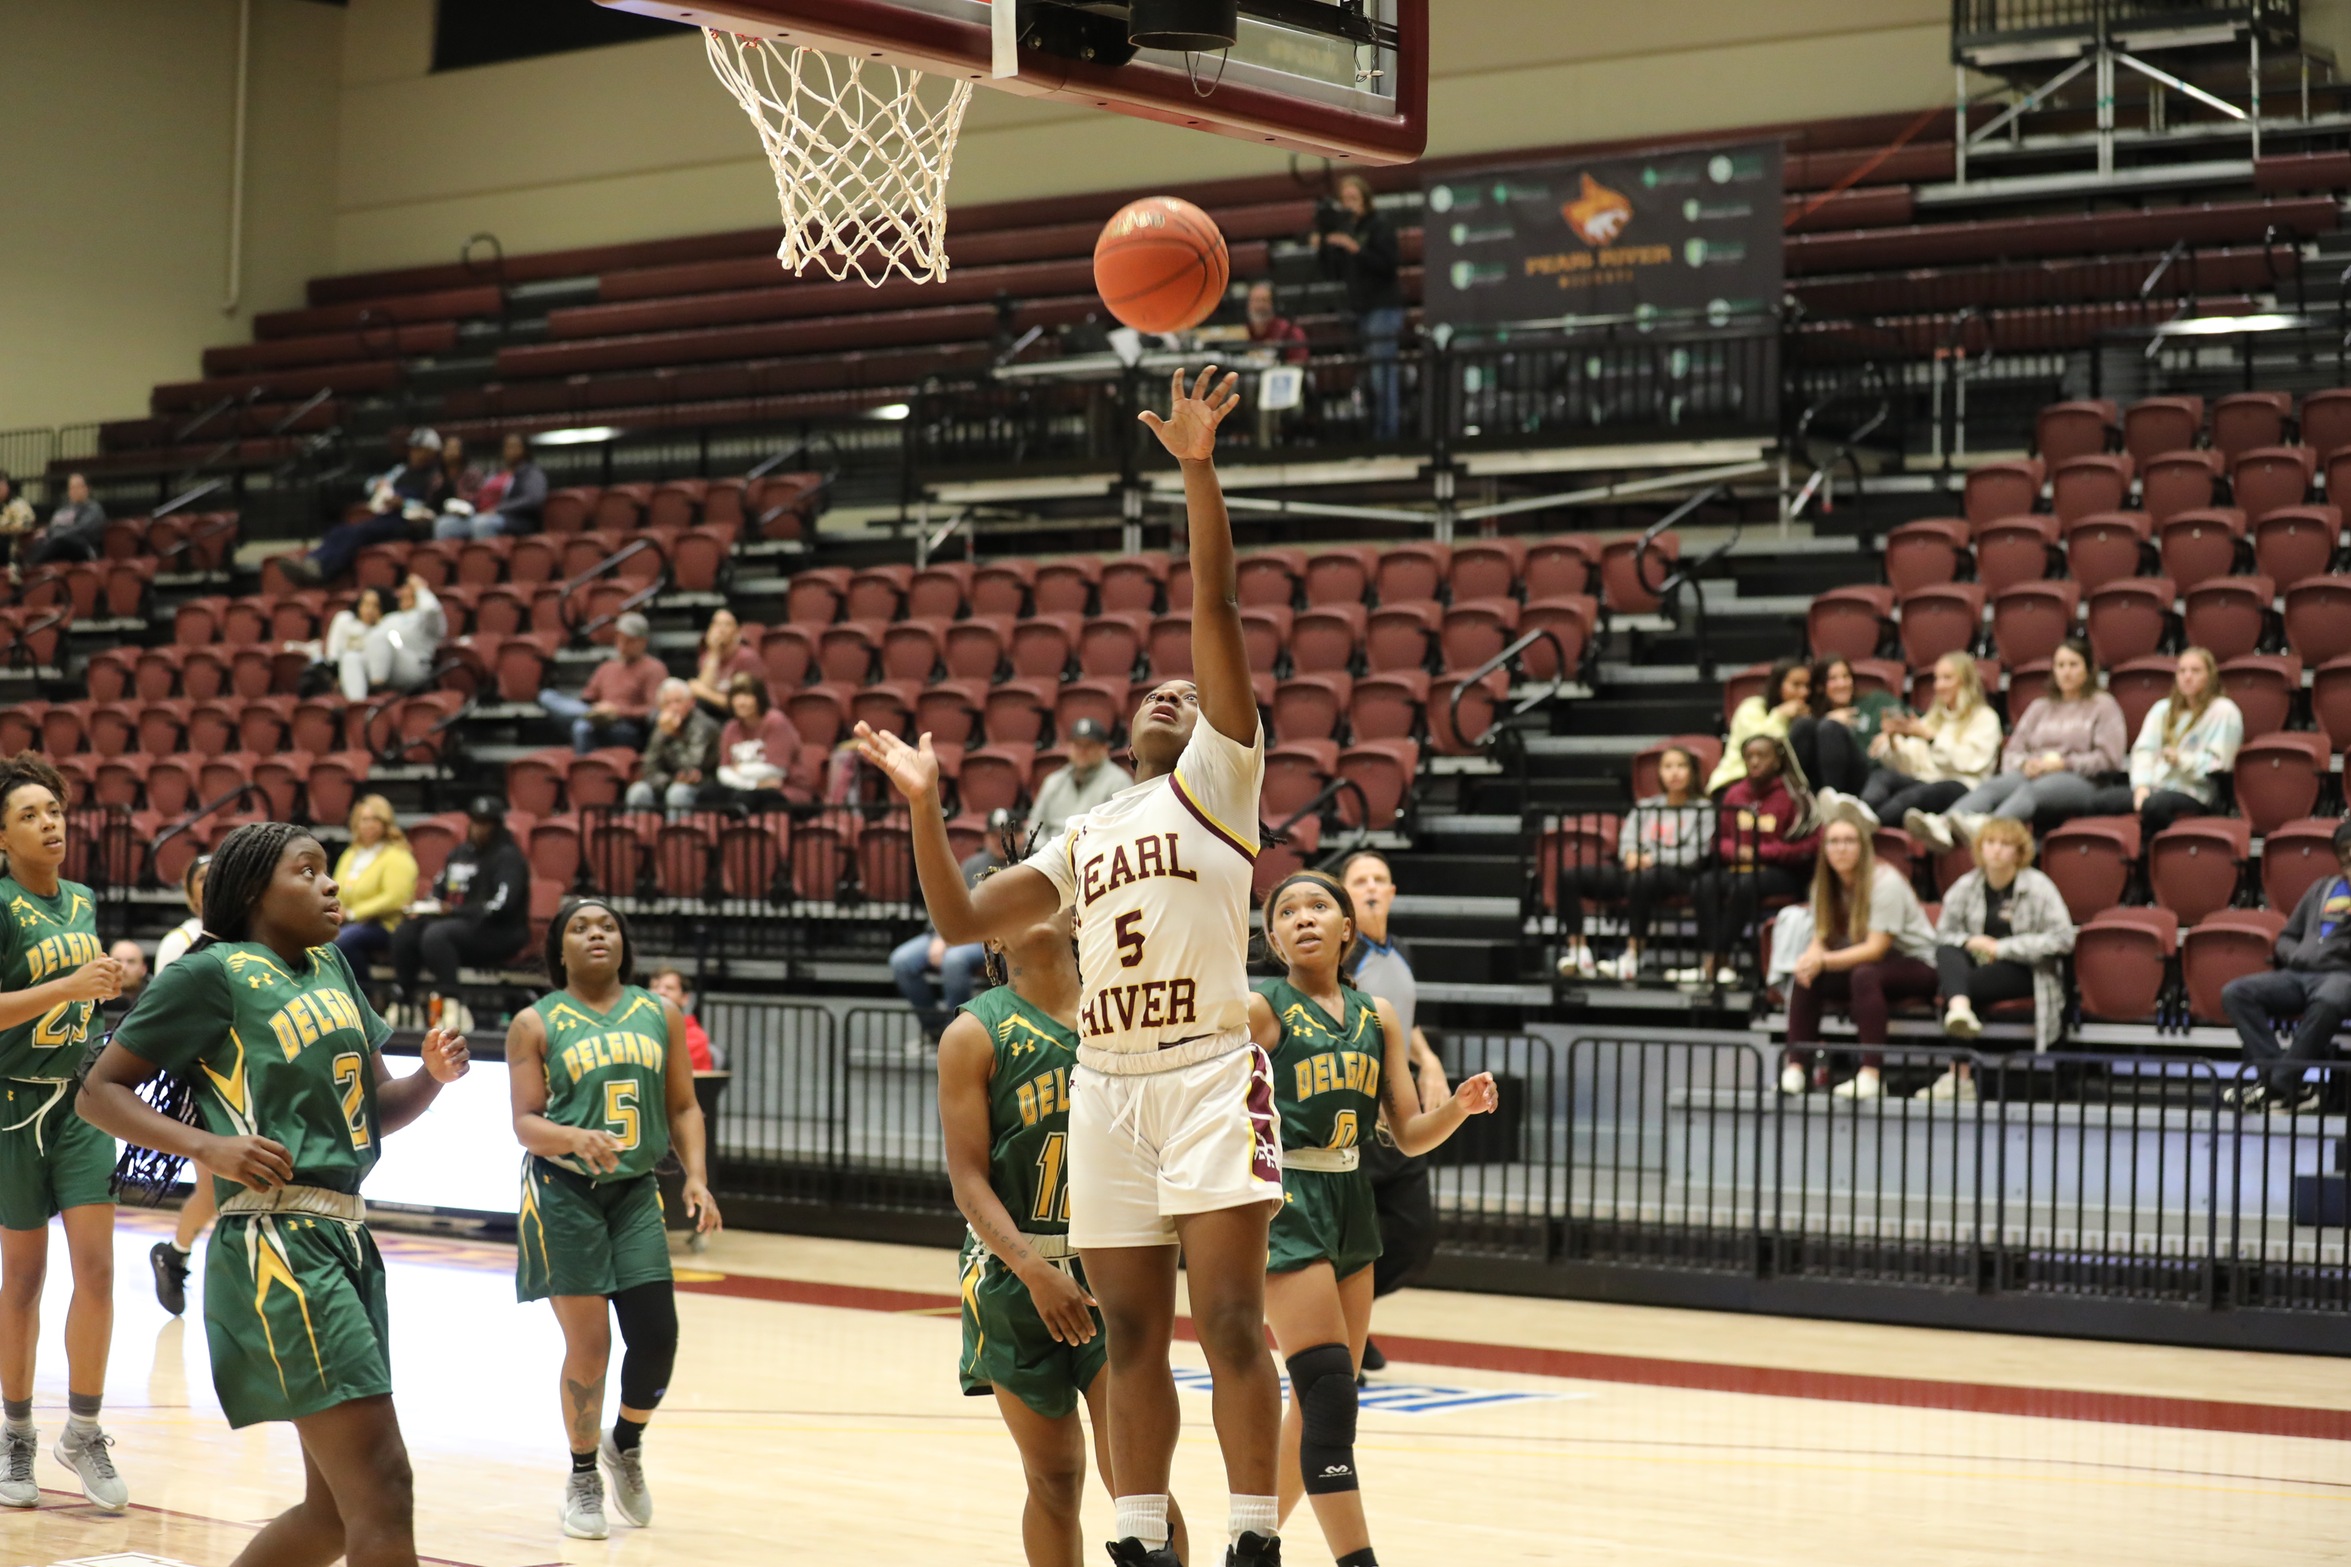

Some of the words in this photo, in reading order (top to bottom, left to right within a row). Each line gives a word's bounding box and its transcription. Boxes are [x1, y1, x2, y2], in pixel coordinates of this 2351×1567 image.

[1075, 833, 1198, 926] EARL
[1115, 909, 1145, 968] 5
[332, 1051, 371, 1151] 2
[604, 1079, 640, 1150] 5
[1031, 1131, 1070, 1222] 1
